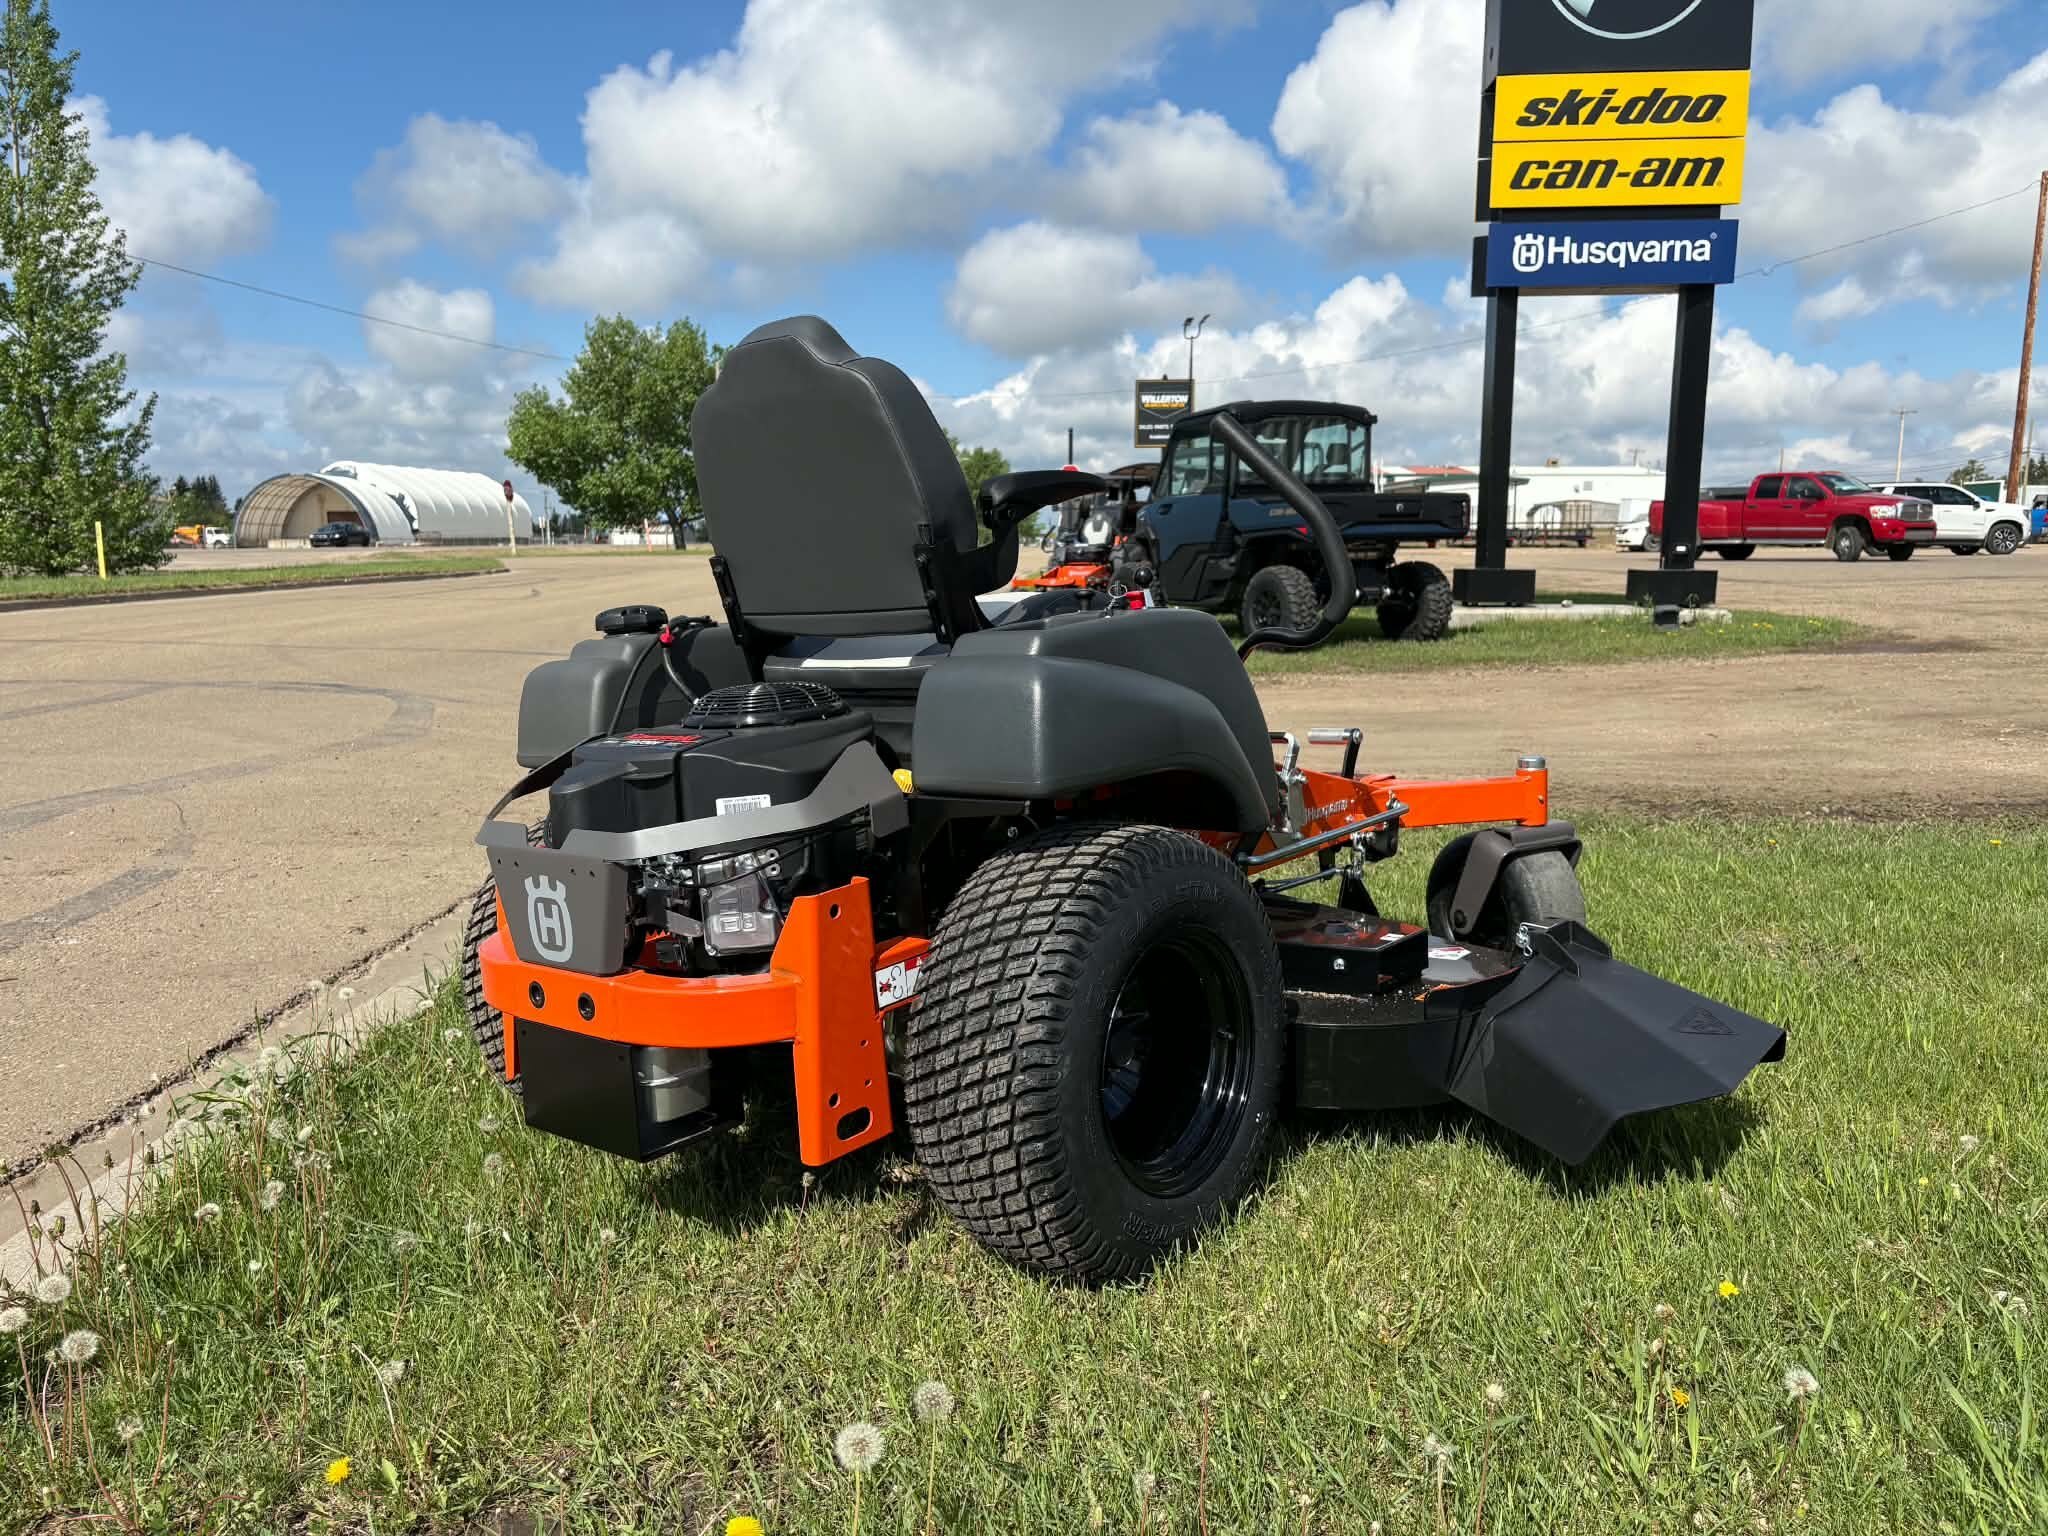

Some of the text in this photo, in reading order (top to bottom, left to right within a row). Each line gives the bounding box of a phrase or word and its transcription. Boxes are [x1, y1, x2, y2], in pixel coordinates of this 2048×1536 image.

[1515, 88, 1727, 127] ski-doo
[1509, 157, 1725, 190] can-am
[1547, 236, 1711, 268] Husqvarna
